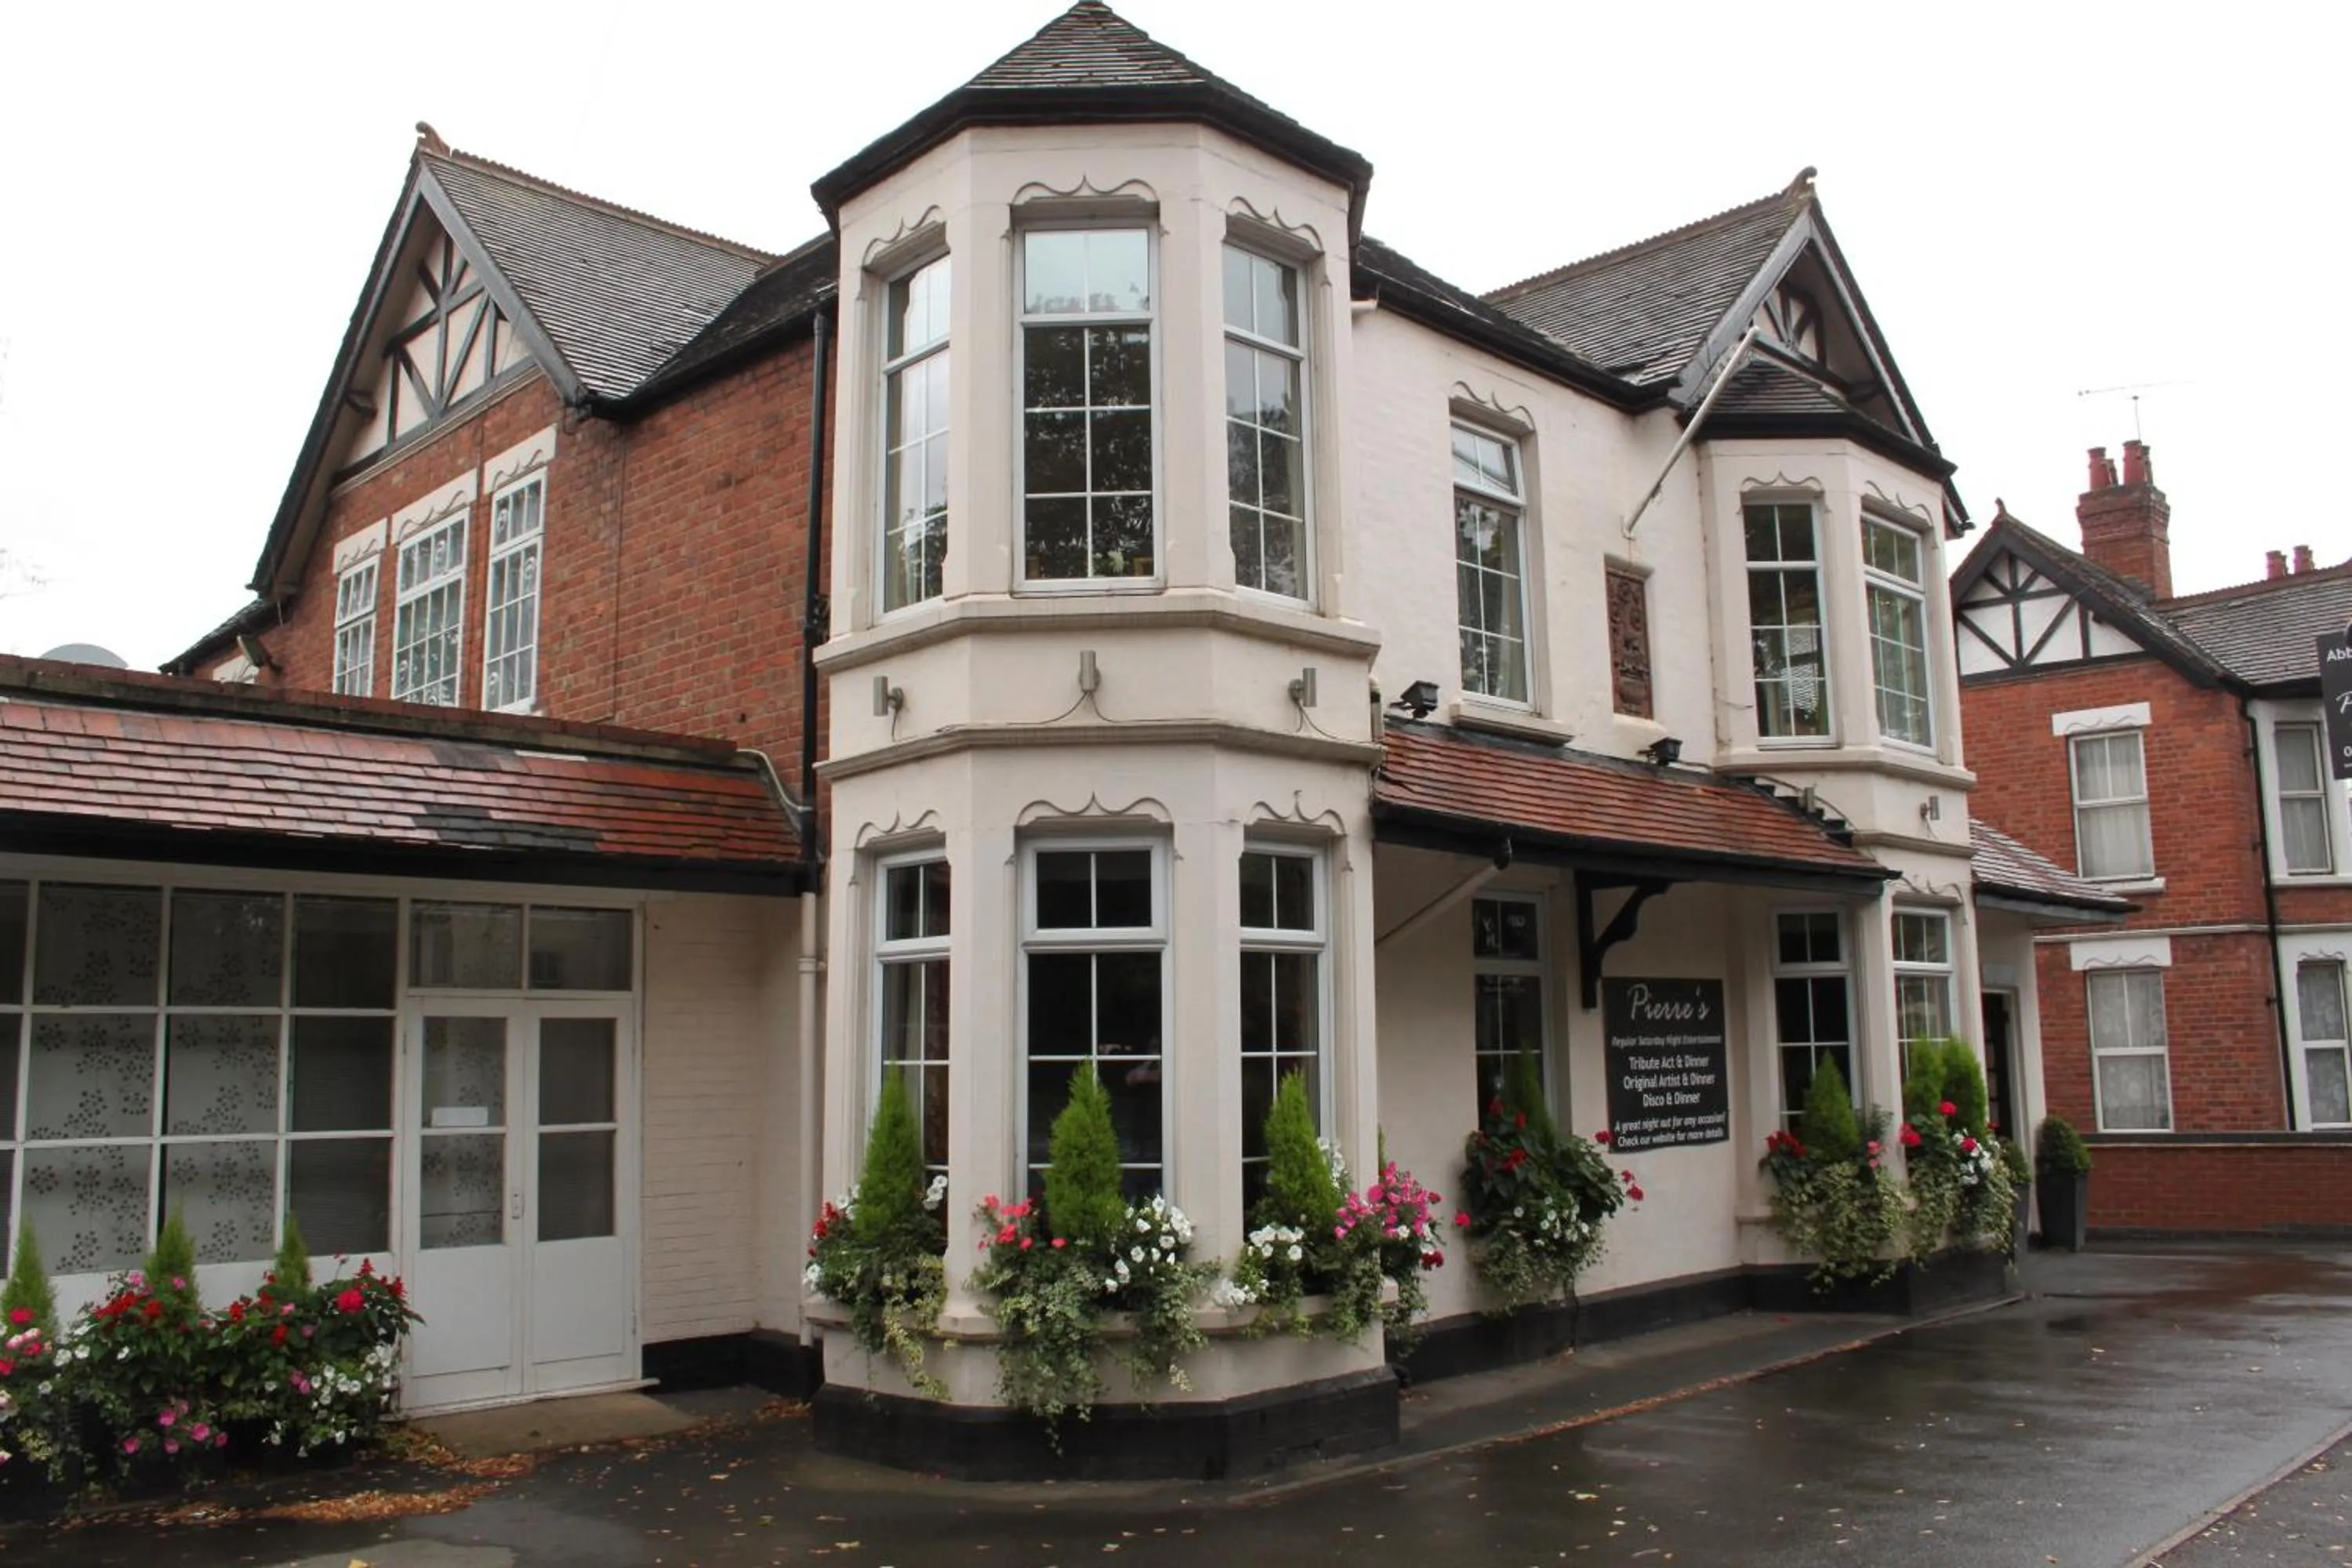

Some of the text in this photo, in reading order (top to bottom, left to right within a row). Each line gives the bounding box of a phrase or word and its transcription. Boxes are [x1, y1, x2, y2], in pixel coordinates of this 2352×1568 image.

[1627, 982, 1710, 1021] Pierre's
[1628, 1054, 1710, 1070] Tribute Act & Dinner
[1623, 1072, 1716, 1092] Original Artist & Dinner
[1642, 1091, 1700, 1108] Disco & Dinner
[1614, 1120, 1621, 1131] A
[1621, 1120, 1640, 1134] great
[1642, 1116, 1659, 1131] night
[1660, 1116, 1671, 1128] out
[1671, 1116, 1682, 1129] for
[1683, 1116, 1697, 1128] any
[1617, 1135, 1639, 1147] Check
[1639, 1136, 1650, 1145] our
[1652, 1132, 1675, 1143] website
[1676, 1131, 1686, 1141] for
[1687, 1131, 1704, 1140] more
